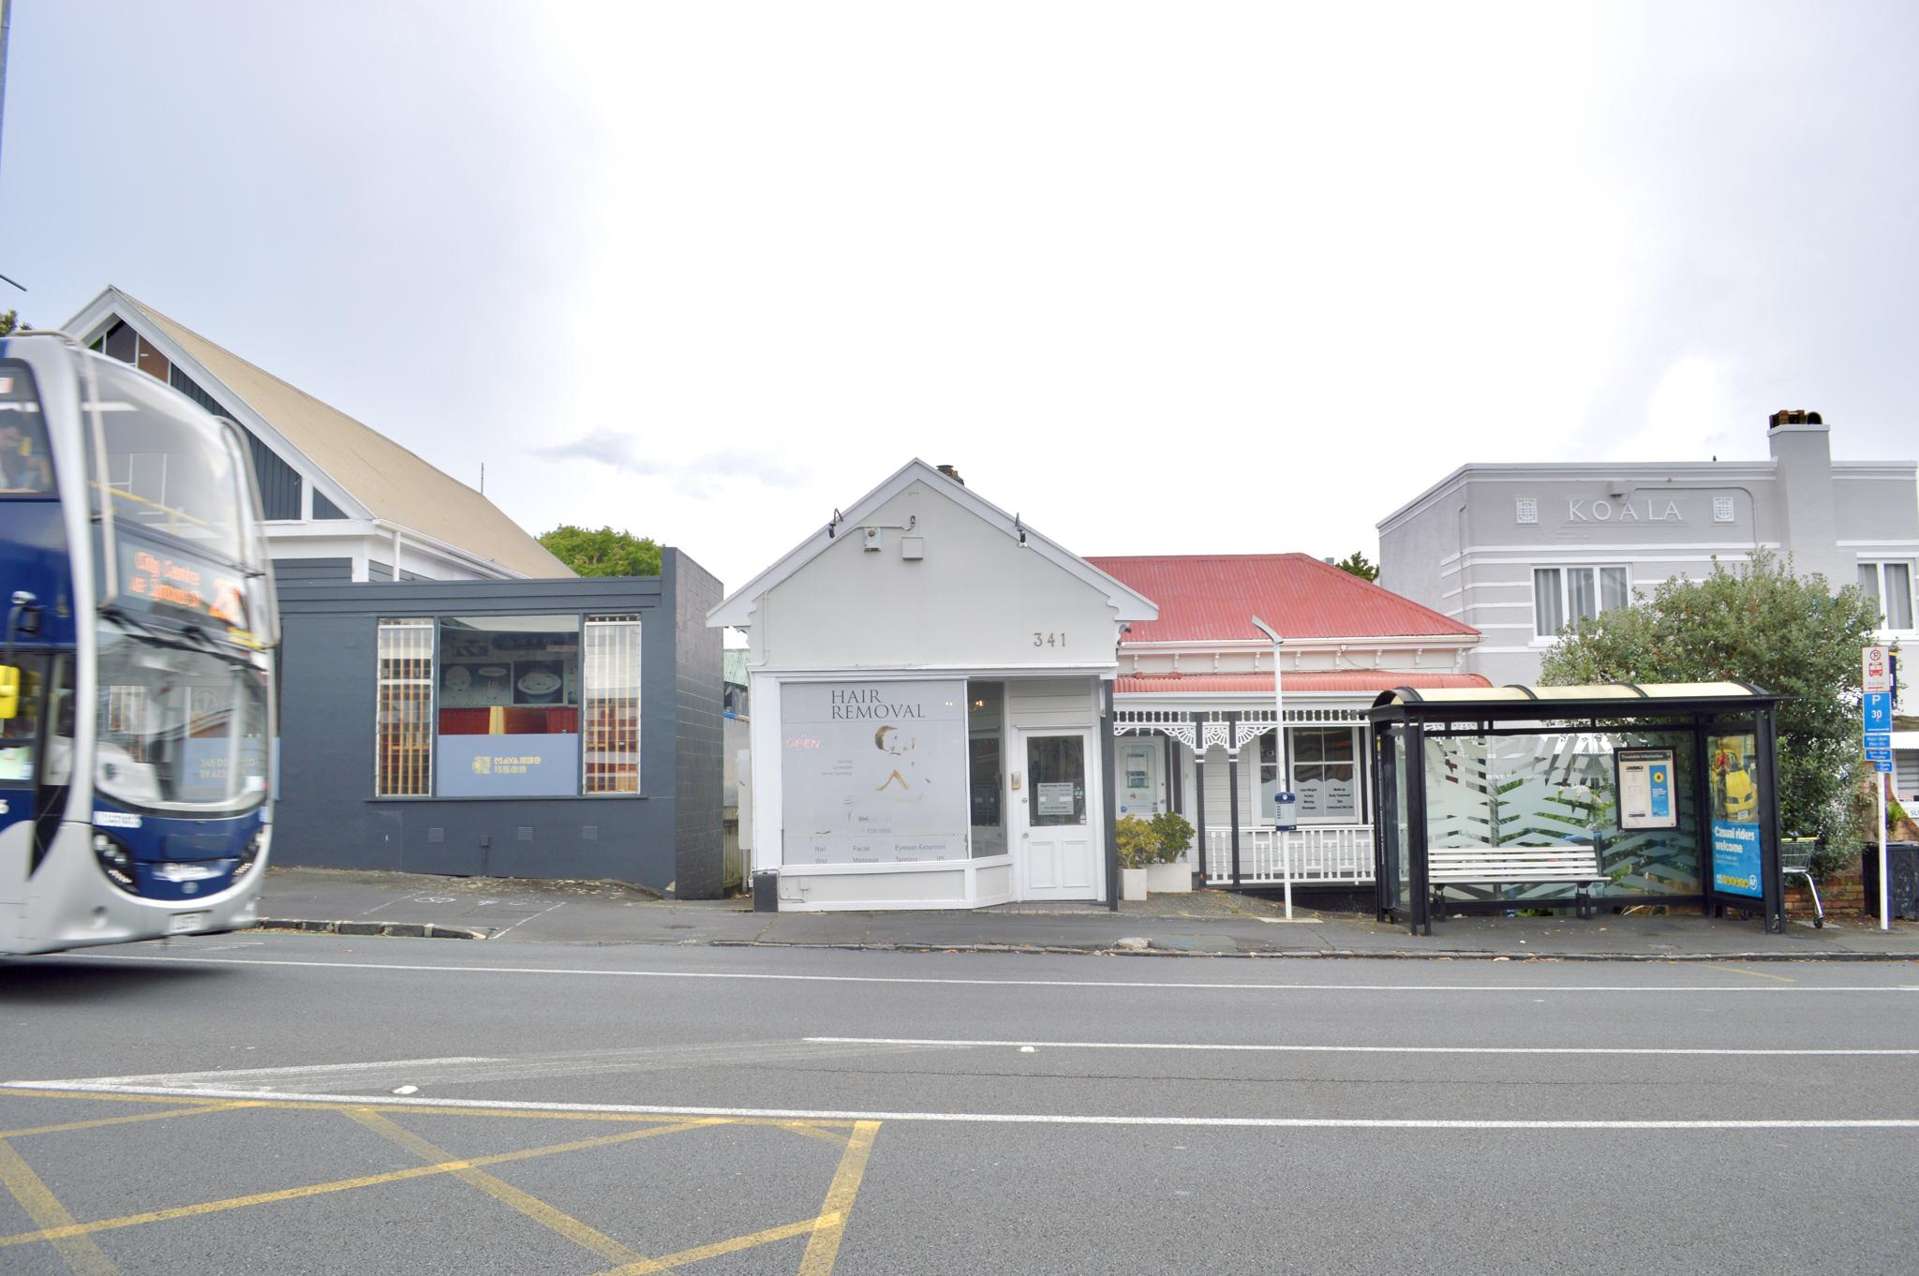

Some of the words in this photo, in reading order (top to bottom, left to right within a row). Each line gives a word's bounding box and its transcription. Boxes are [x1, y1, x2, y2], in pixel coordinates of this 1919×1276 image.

[1568, 499, 1683, 521] KOALA
[1034, 632, 1066, 648] 341
[831, 689, 882, 704] HAIR
[1872, 694, 1881, 705] P
[832, 703, 926, 720] REMOVAL
[1871, 709, 1883, 719] 30
[1715, 840, 1744, 853] welcome
